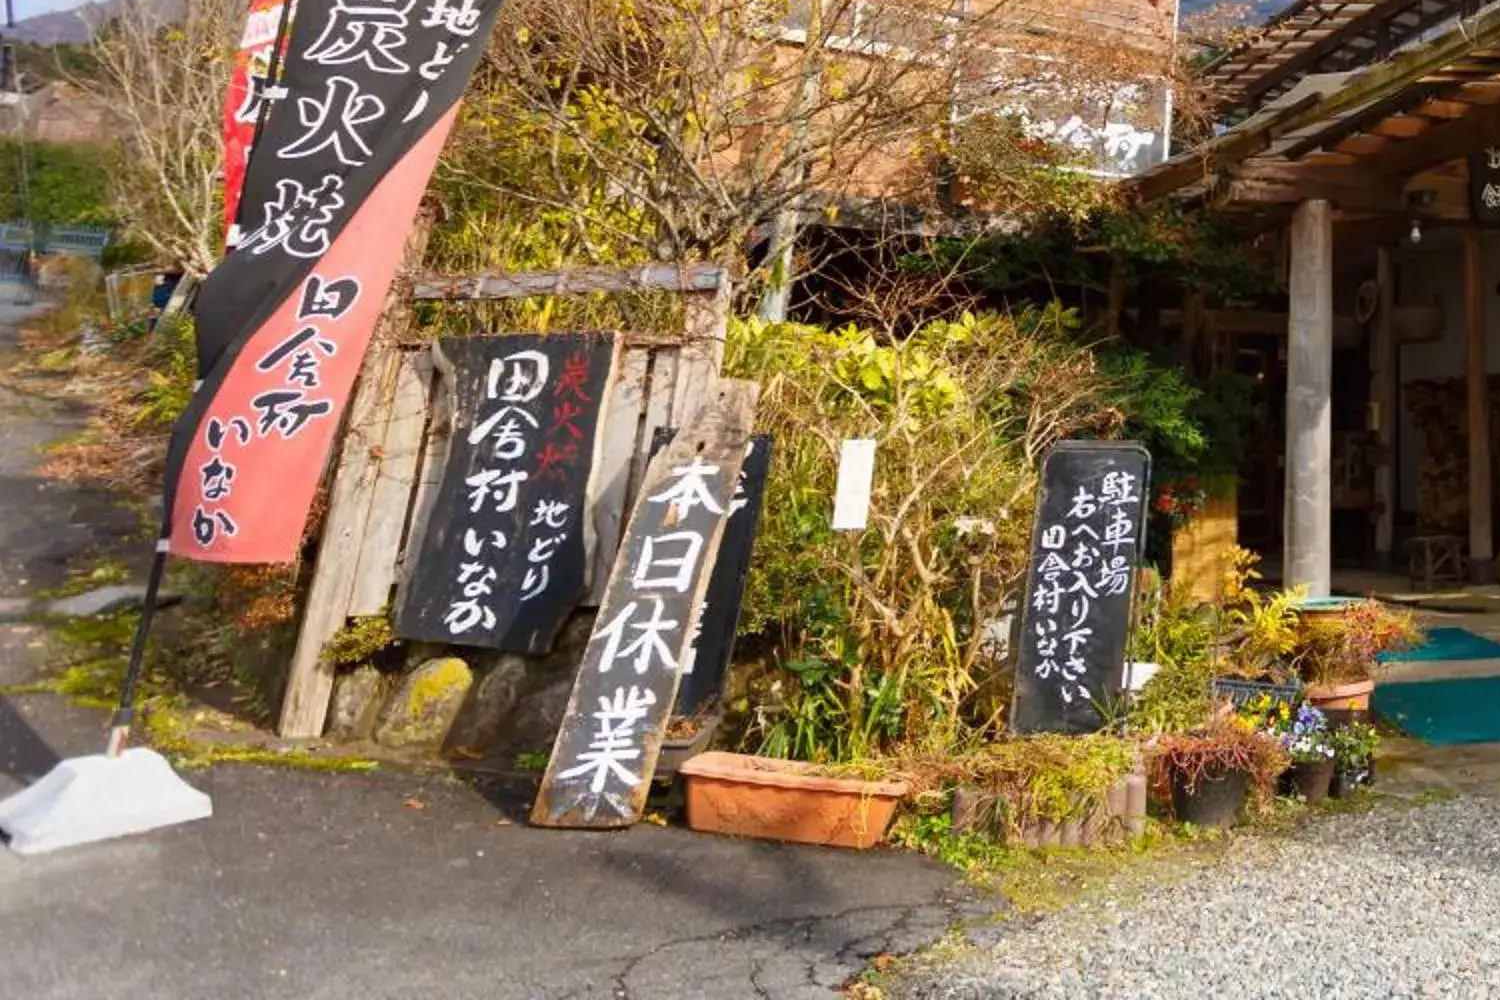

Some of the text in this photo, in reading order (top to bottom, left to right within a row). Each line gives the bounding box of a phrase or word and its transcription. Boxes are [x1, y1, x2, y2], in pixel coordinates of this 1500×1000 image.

[192, 416, 250, 546] いなか
[443, 349, 550, 635] 田舎村いなか
[520, 499, 569, 601] 地どり
[1096, 471, 1139, 597] 駐車場
[556, 456, 727, 793] 本日休業
[1061, 485, 1100, 703] 右へお入り下さい
